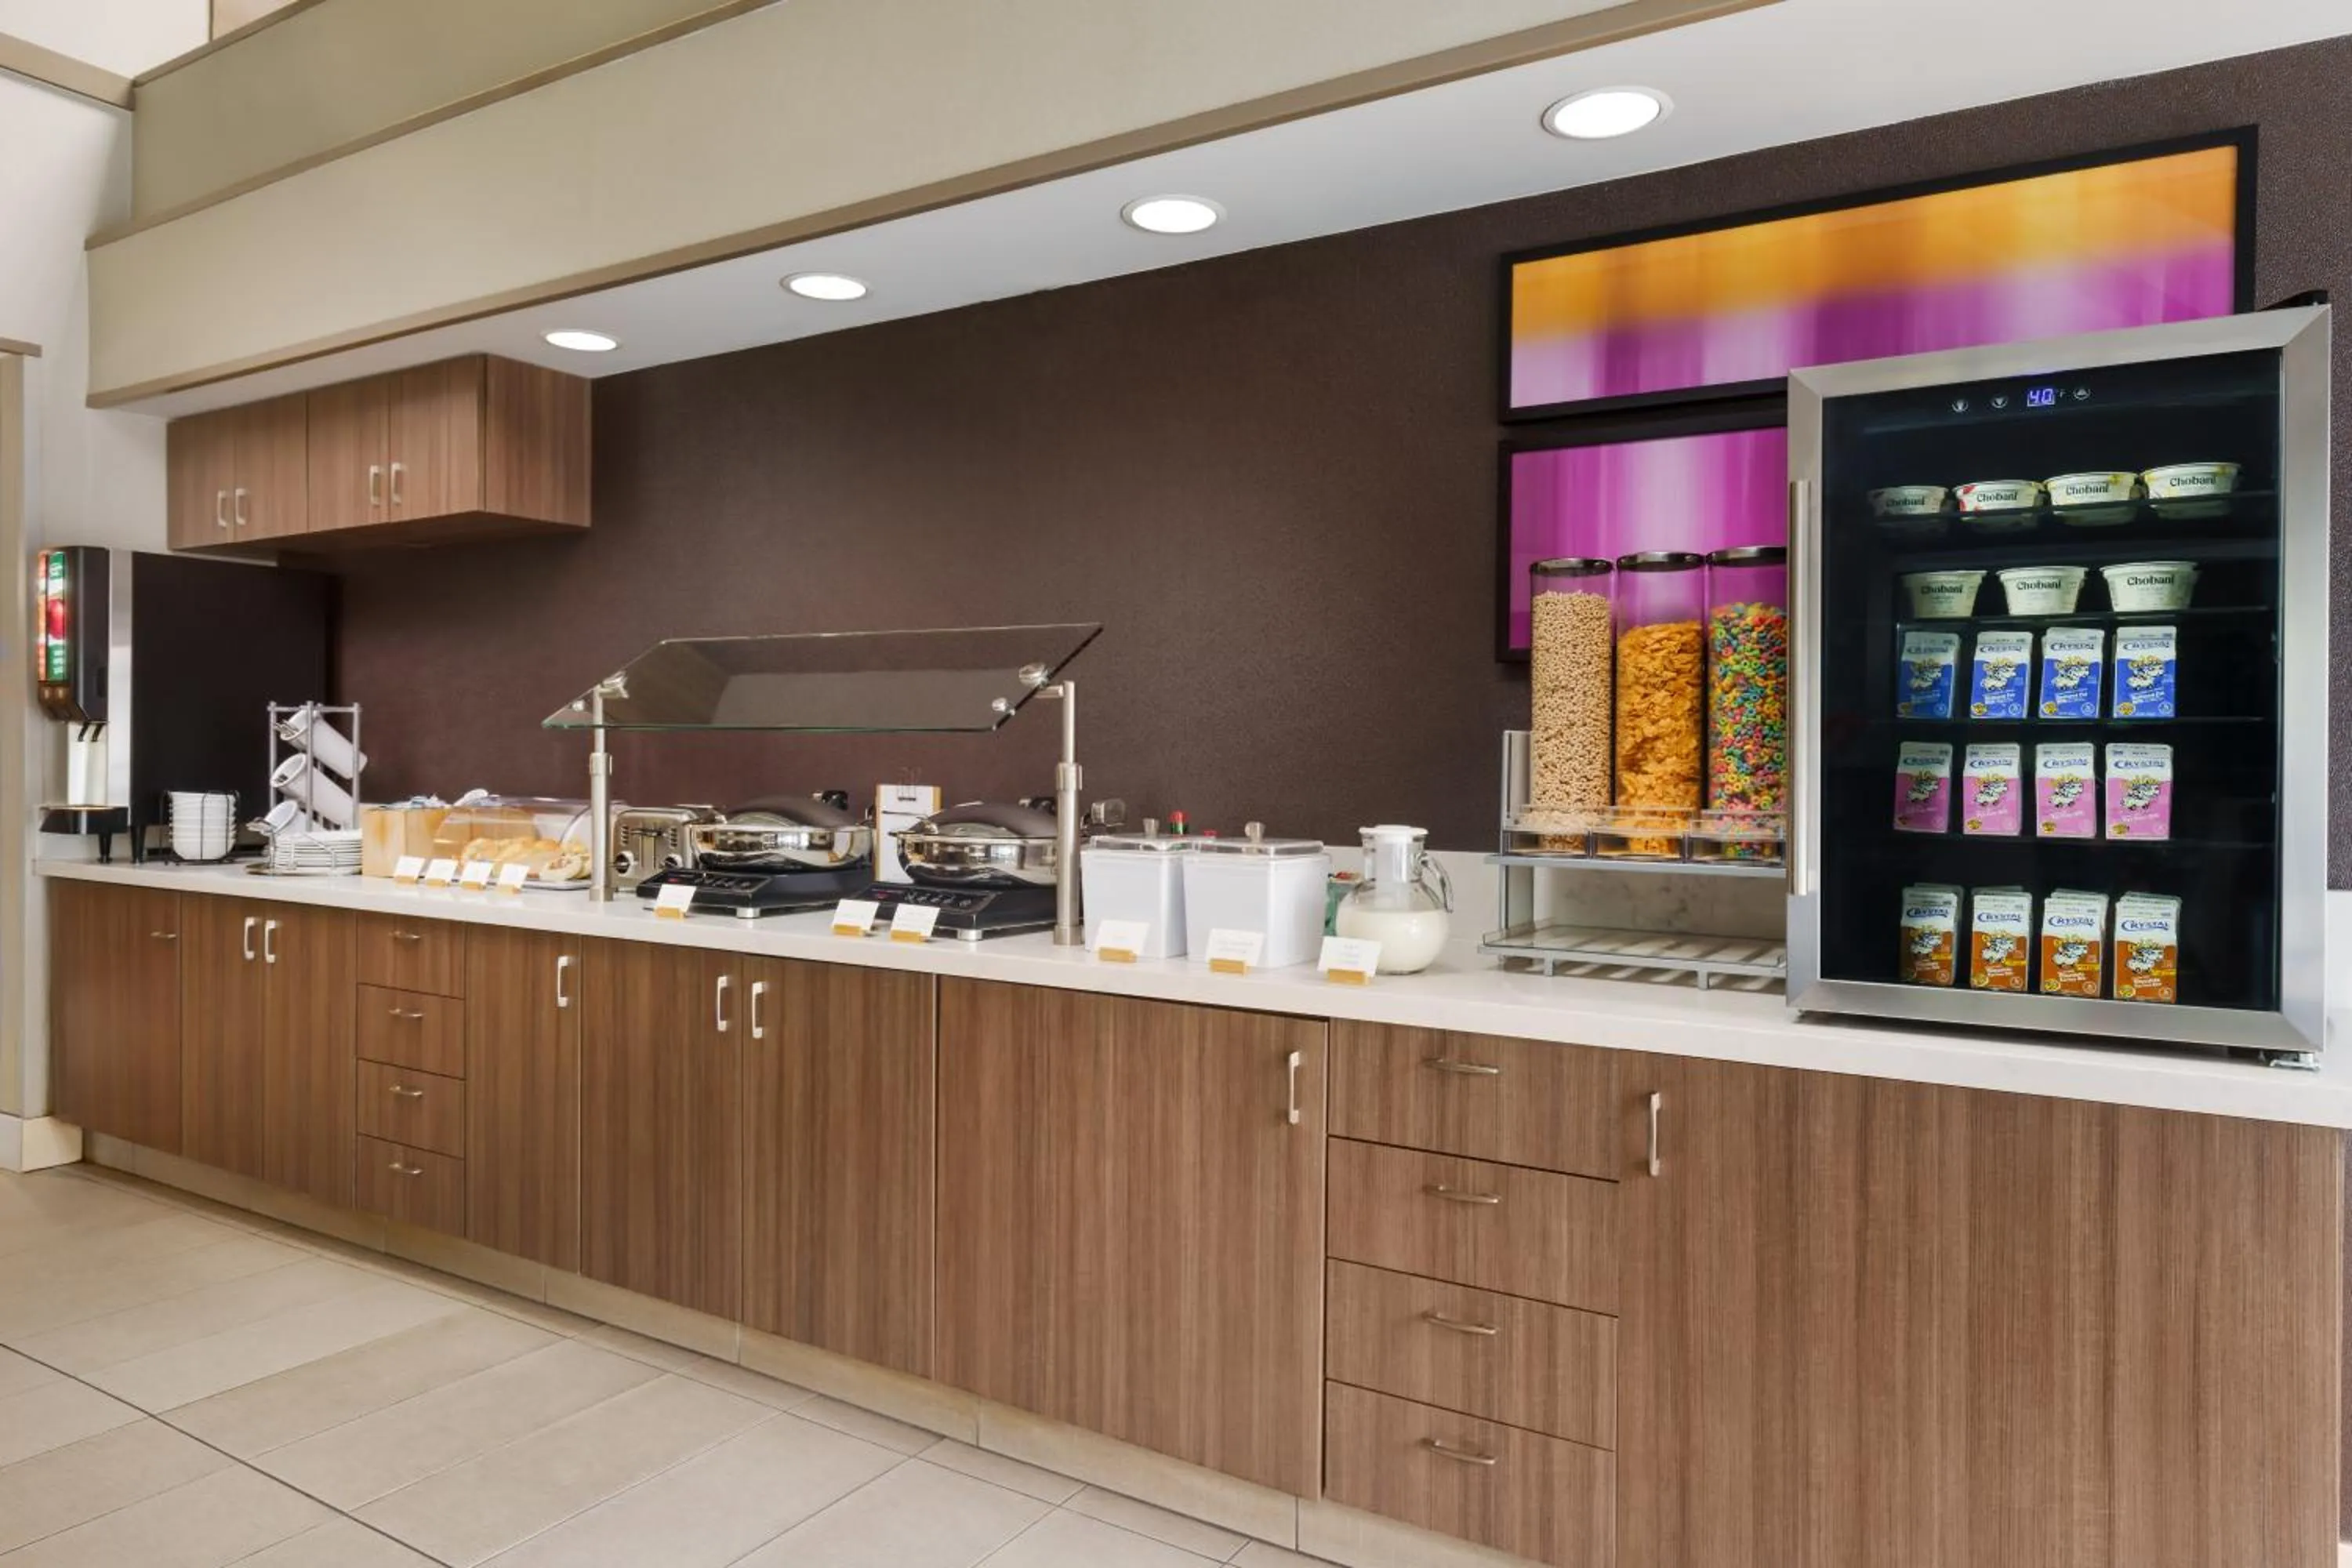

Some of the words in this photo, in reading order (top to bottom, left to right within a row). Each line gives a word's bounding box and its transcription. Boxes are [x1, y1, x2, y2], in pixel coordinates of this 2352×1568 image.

[2028, 388, 2054, 405] 40
[2169, 474, 2216, 487] Chobani
[2066, 482, 2109, 495] Chobani
[1976, 491, 2018, 503] Chobani
[2016, 579, 2061, 590] Chobani
[2126, 574, 2175, 586] Chobani
[1921, 584, 1964, 594] Chobani
